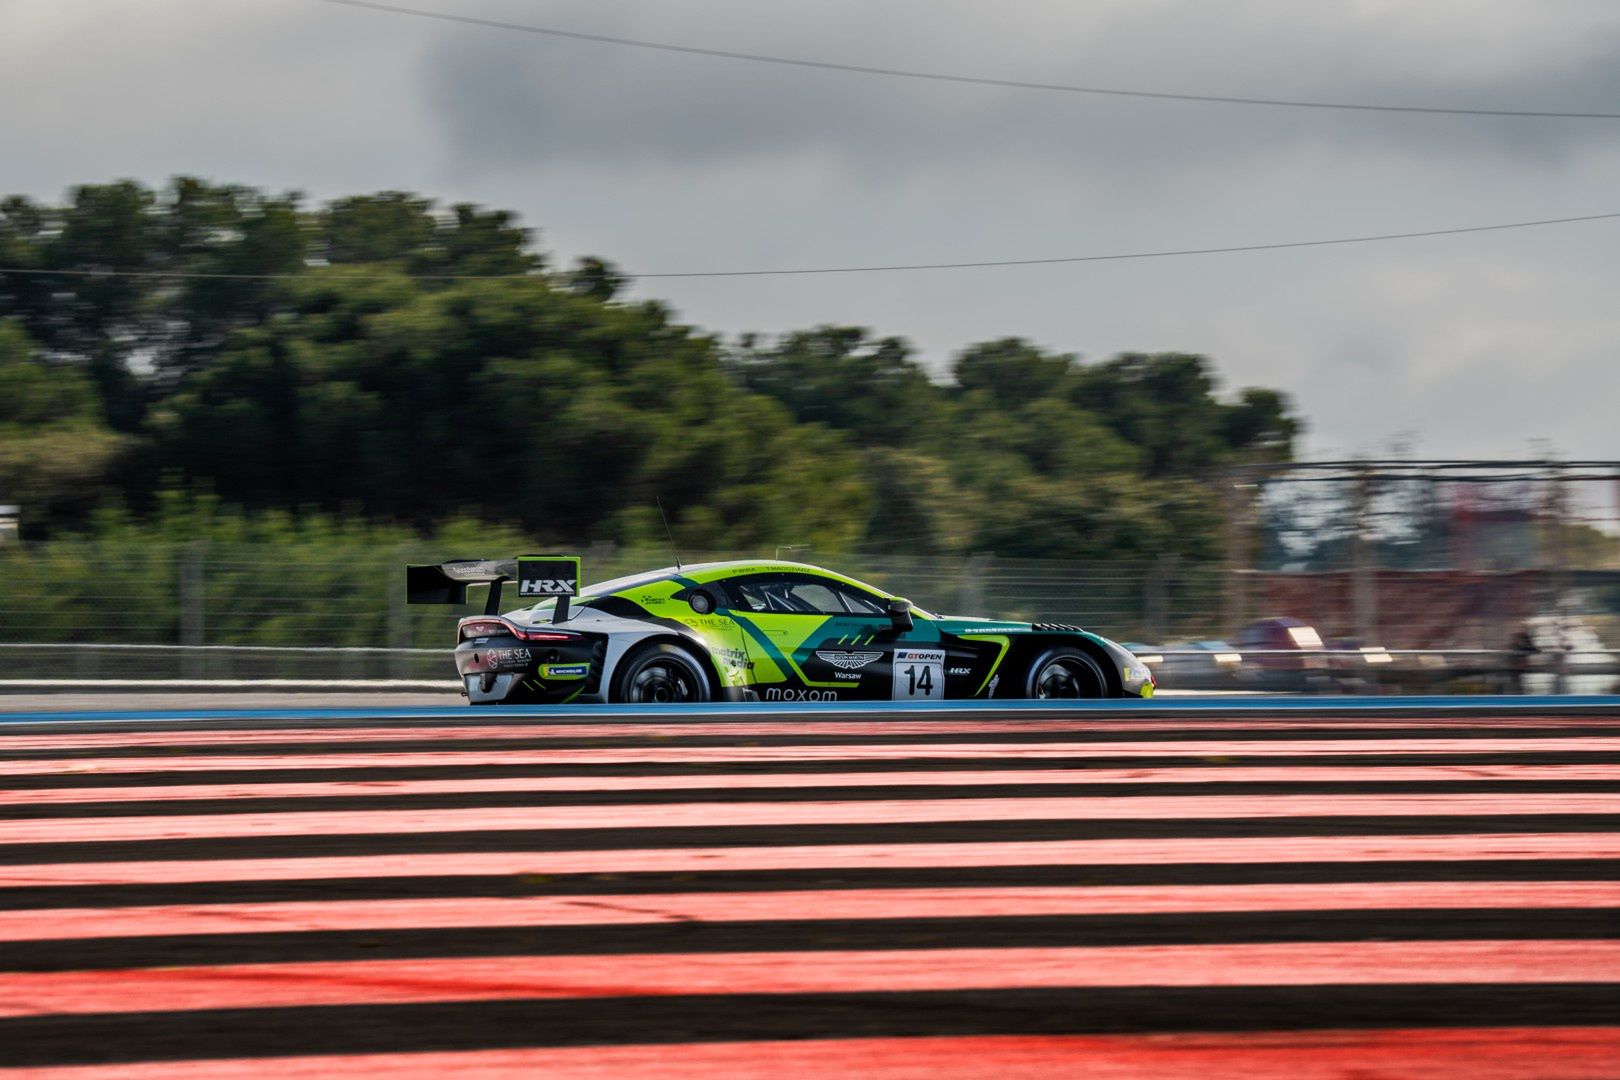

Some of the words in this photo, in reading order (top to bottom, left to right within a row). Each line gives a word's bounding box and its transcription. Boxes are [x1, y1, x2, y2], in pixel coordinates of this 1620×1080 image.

[520, 579, 577, 593] HRX
[499, 650, 513, 660] THE
[514, 648, 532, 660] SEA
[834, 671, 862, 679] Warsaw
[904, 664, 934, 696] 14
[765, 687, 838, 701] moxom
